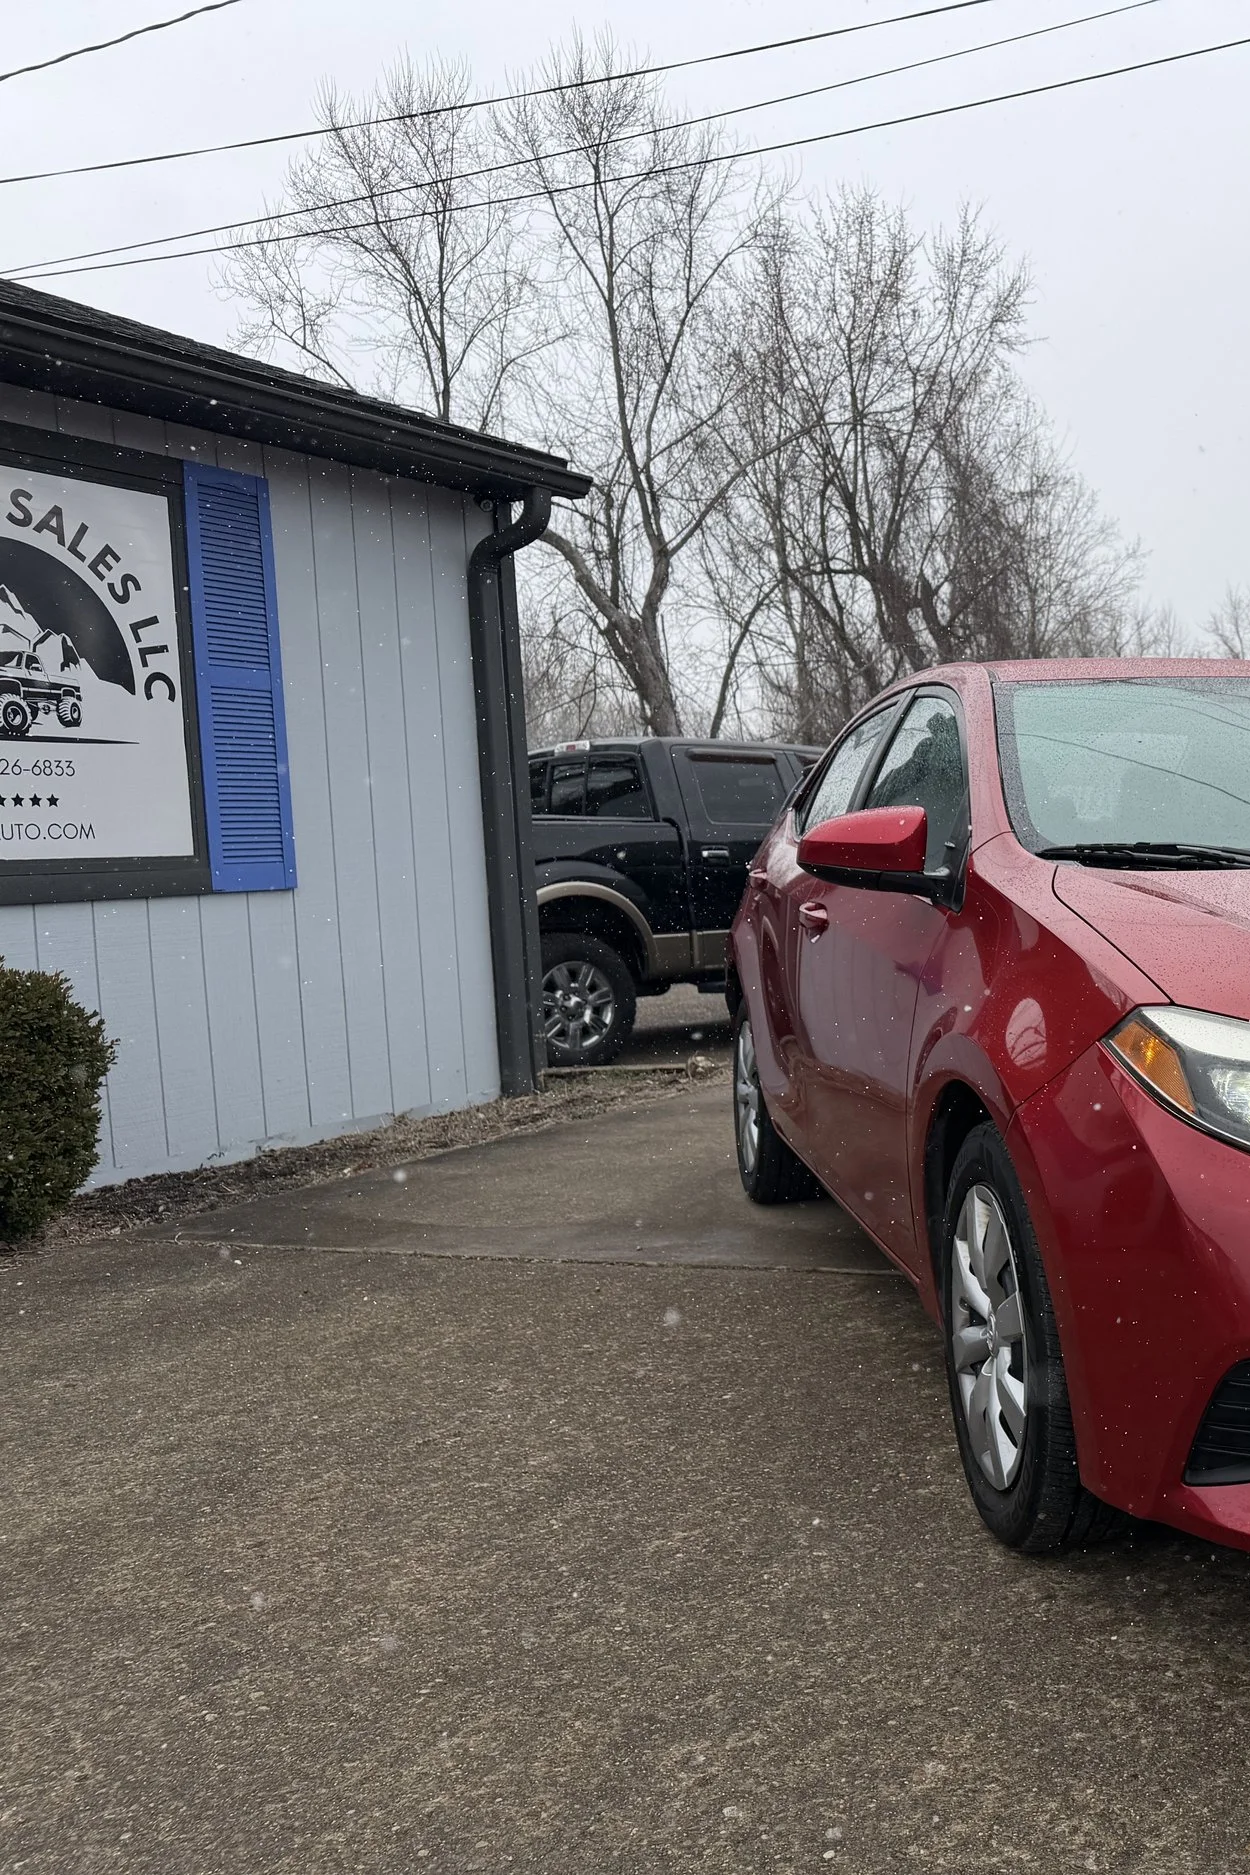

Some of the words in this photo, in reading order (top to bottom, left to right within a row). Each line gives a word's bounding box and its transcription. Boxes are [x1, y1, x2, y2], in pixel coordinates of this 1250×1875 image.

[5, 488, 142, 605] SALES
[129, 615, 176, 703] LLC
[0, 758, 76, 777] 26-6833
[0, 823, 96, 840] UTO.COM
